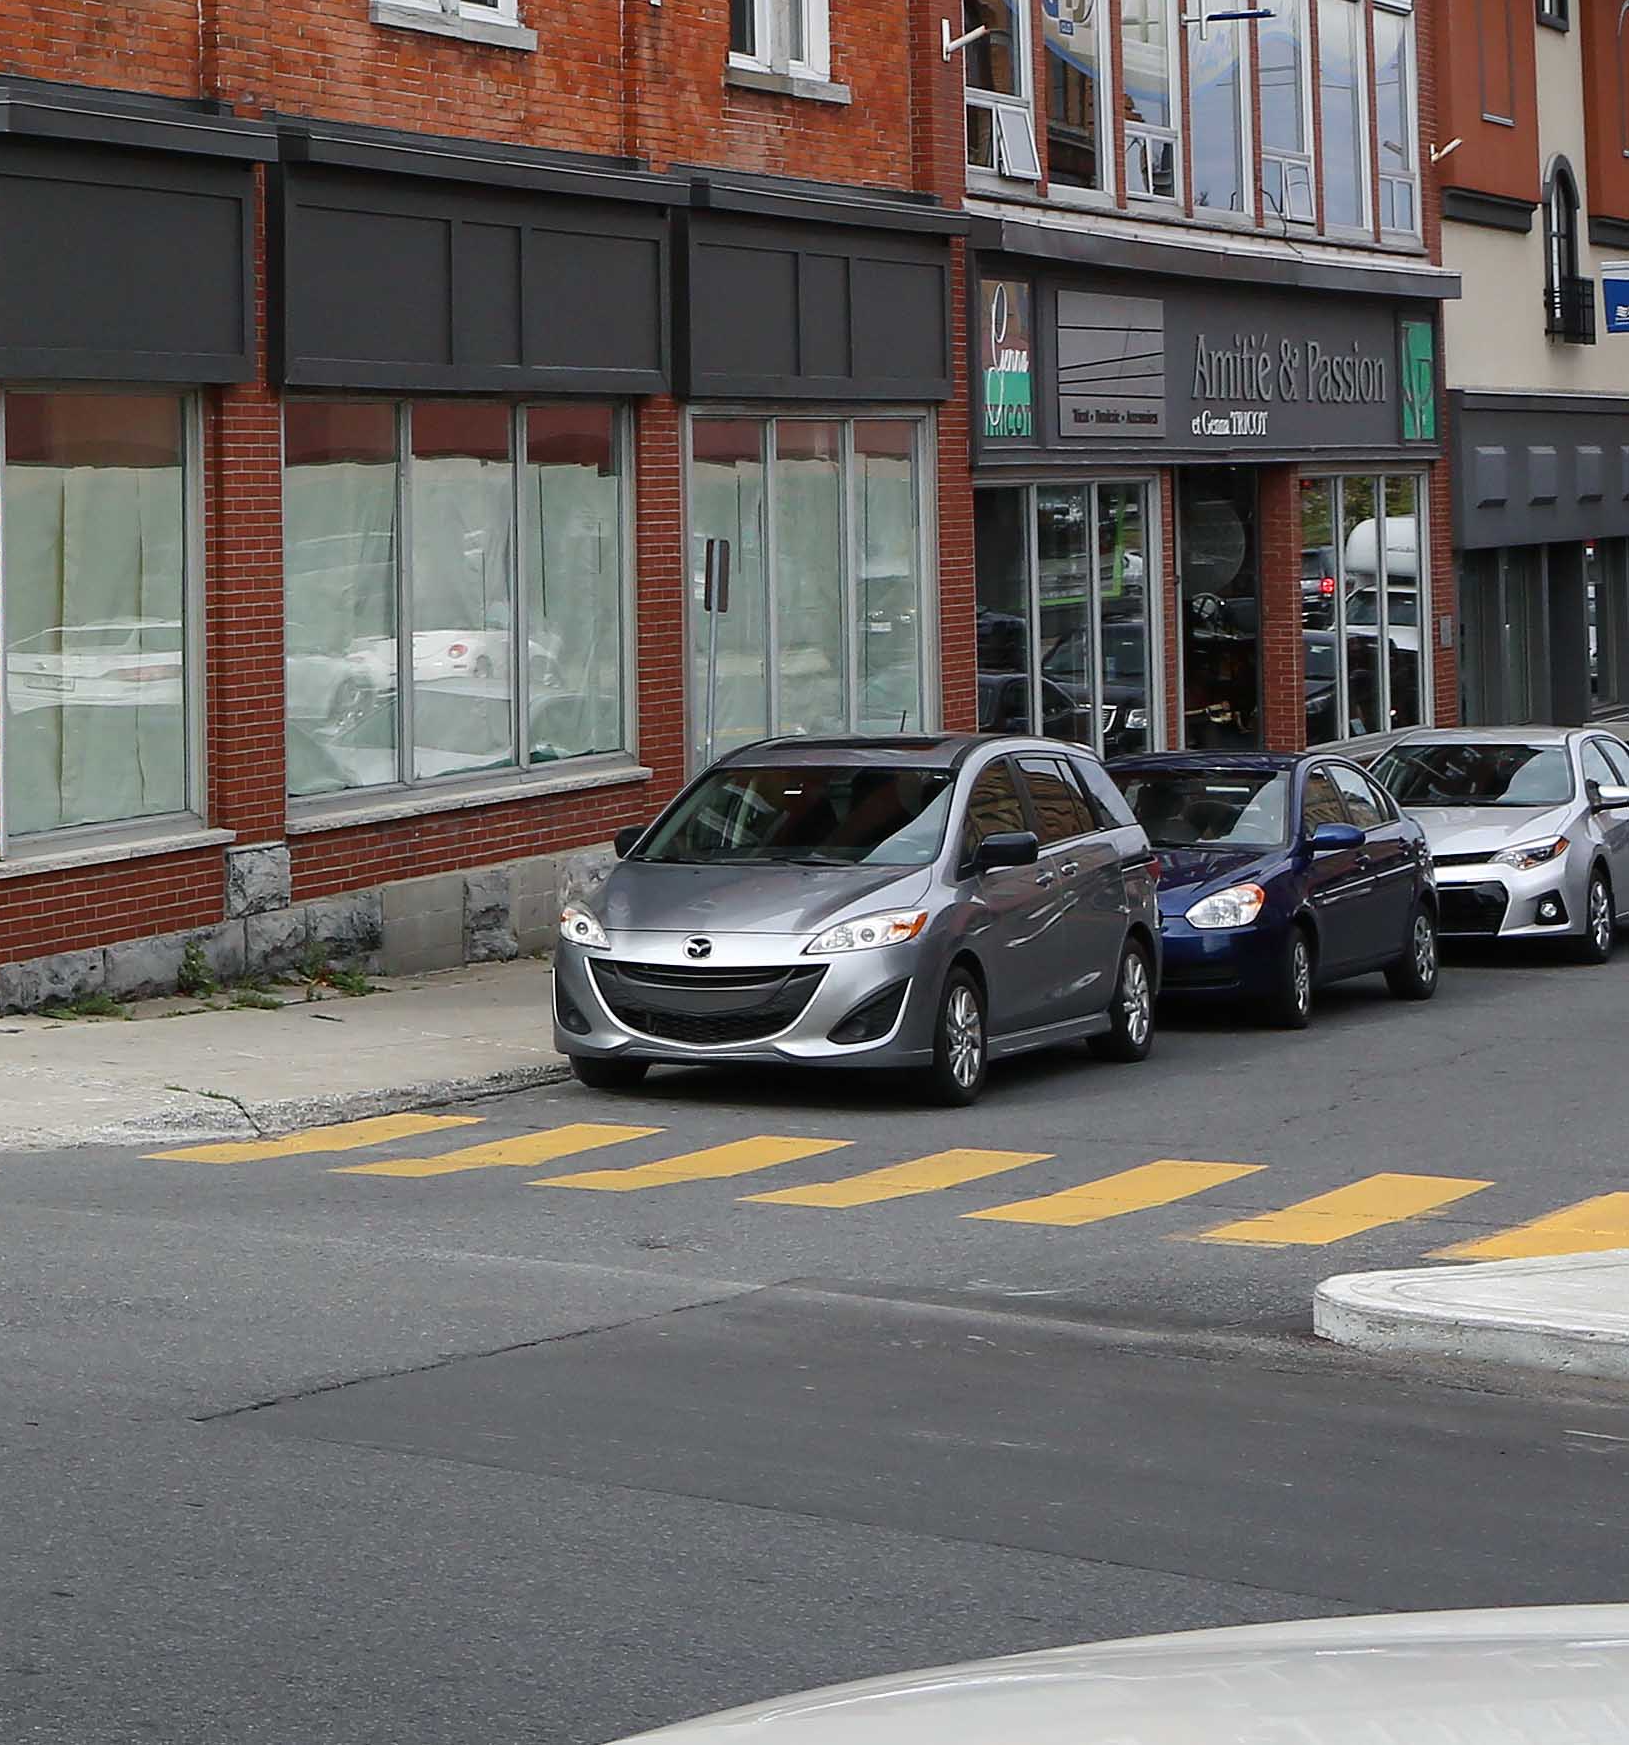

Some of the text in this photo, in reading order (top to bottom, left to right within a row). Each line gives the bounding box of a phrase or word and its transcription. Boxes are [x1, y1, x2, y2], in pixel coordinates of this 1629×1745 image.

[1191, 333, 1386, 403] Amitié & Passion
[1191, 416, 1201, 434] et
[1230, 410, 1268, 435] TRICOT
